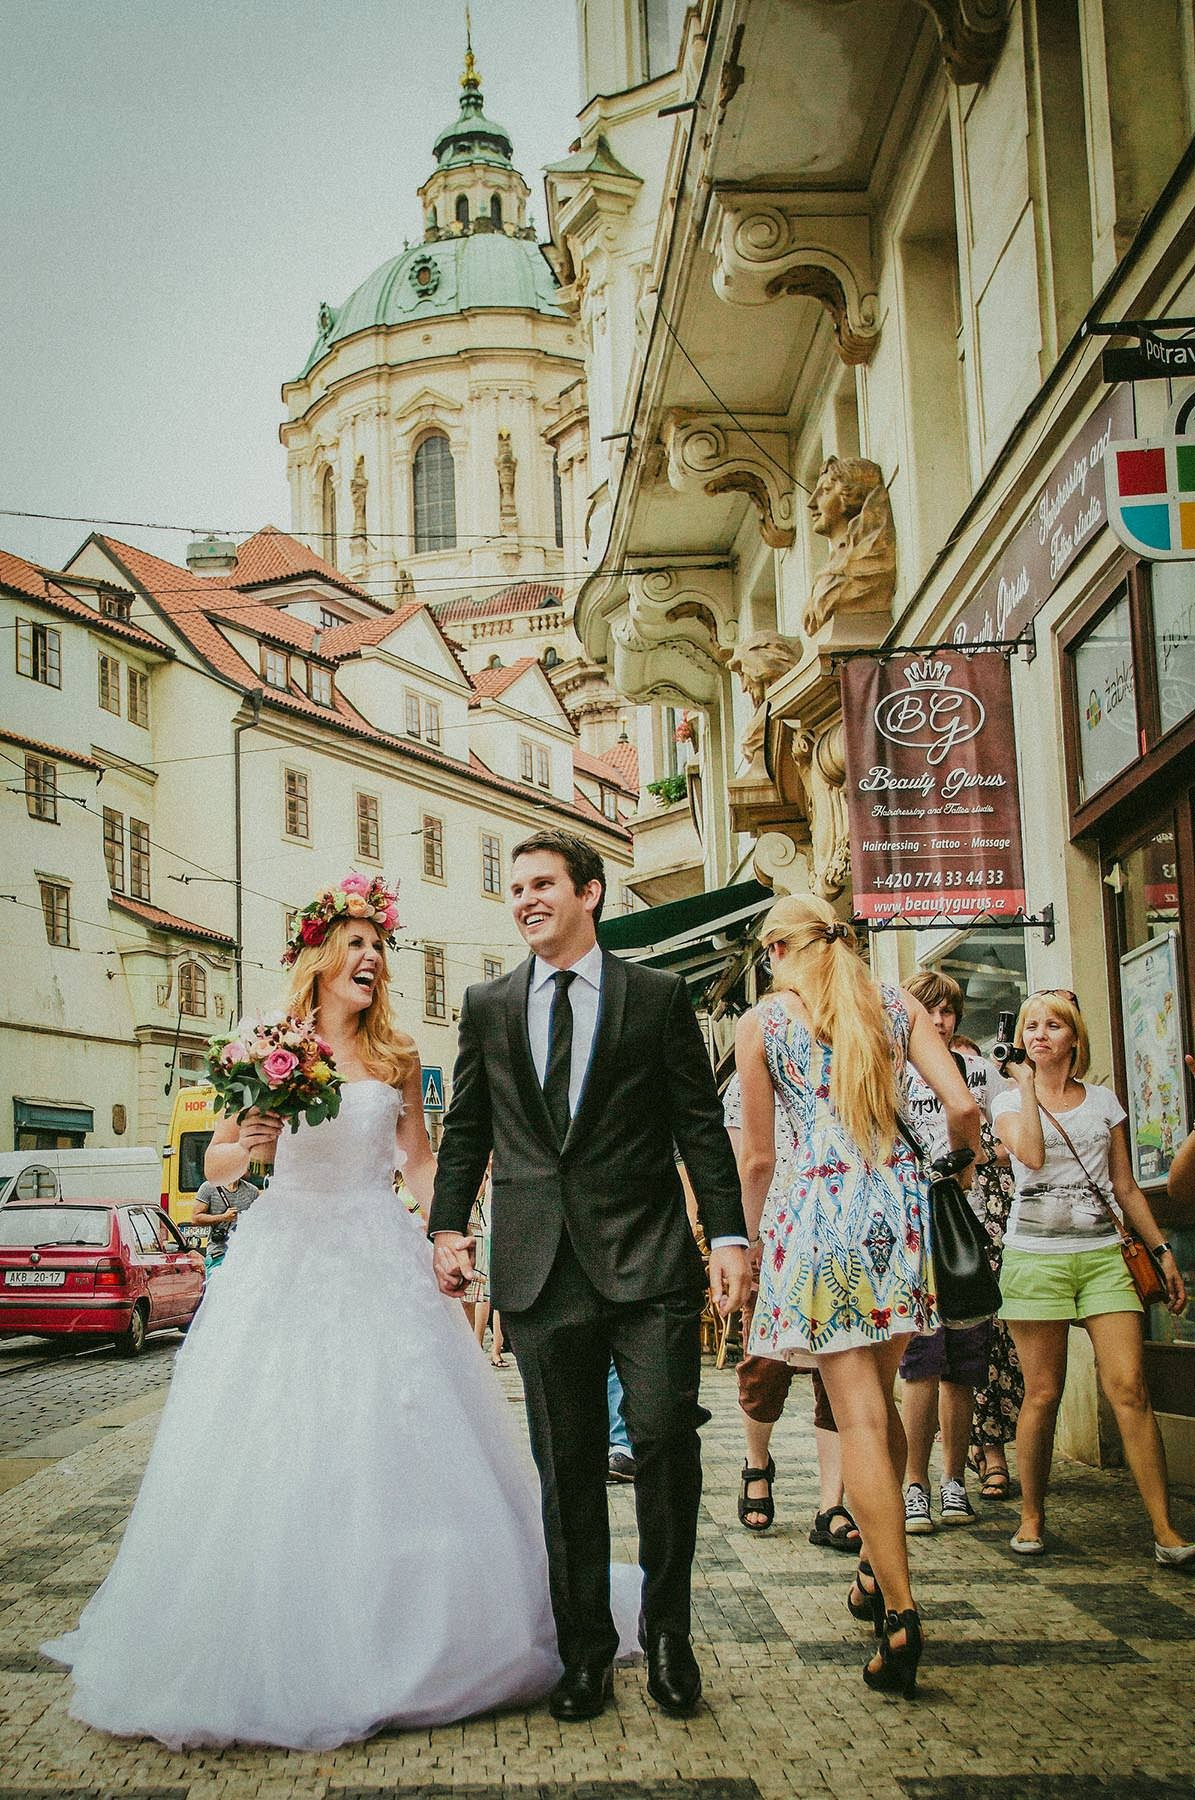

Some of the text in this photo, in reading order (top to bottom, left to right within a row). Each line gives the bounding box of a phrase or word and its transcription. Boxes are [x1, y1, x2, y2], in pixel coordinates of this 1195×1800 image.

[1089, 417, 1112, 469] and
[886, 692, 969, 766] BG
[858, 765, 1007, 799] Beauty Gurus
[871, 802, 994, 819] Hairdressing and Tattoo studio
[862, 840, 920, 853] Hairdressing
[930, 838, 961, 849] Tattoo
[971, 837, 1011, 850] Massage
[873, 869, 1004, 889] +420 774 33 44 33
[873, 895, 1006, 915] www.beautygurus.cz
[9, 1272, 28, 1283] AKB
[33, 1272, 61, 1283] 20-17
